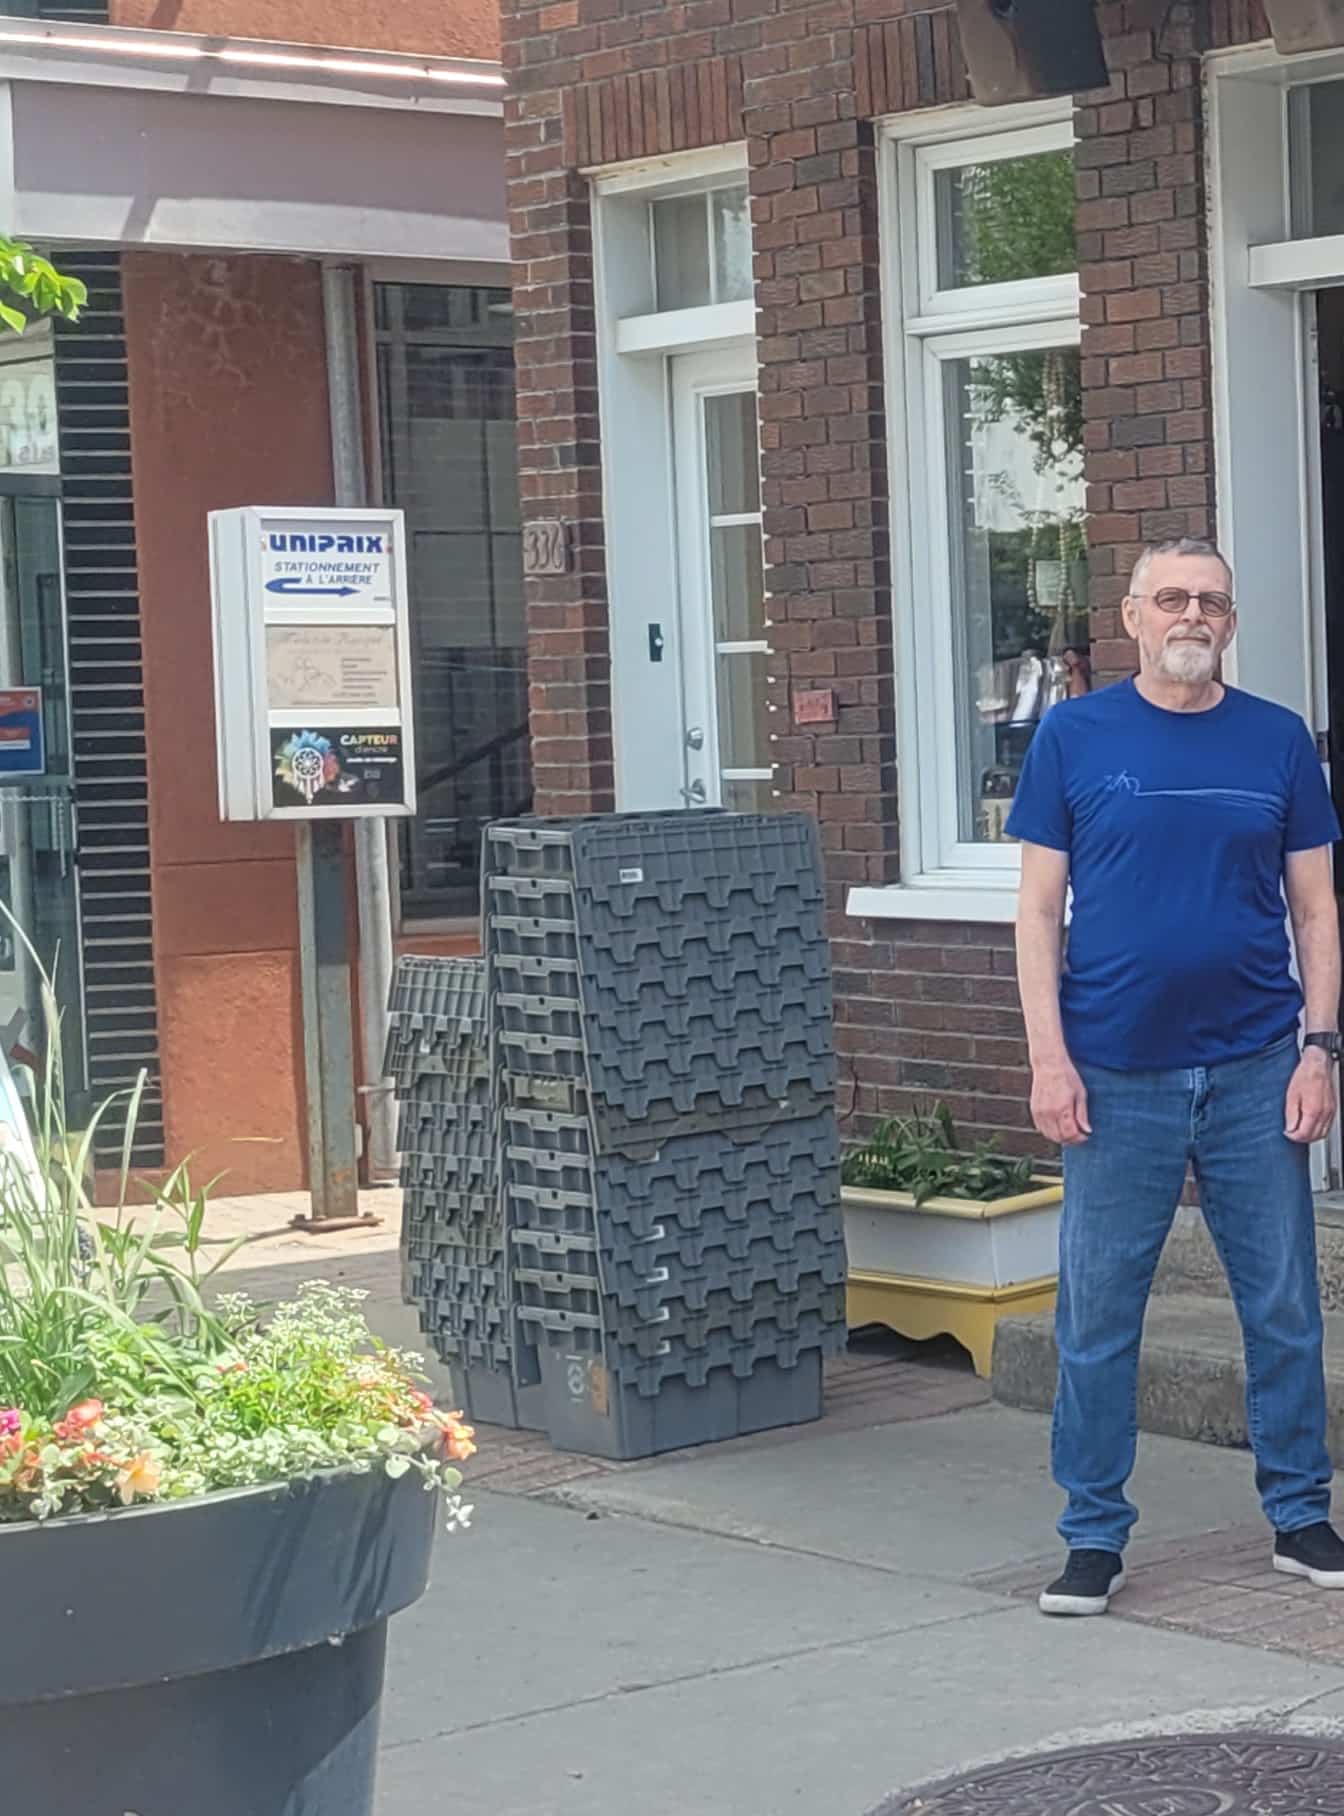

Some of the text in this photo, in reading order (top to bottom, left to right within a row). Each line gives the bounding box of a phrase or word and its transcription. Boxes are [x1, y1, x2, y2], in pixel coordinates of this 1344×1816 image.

[269, 533, 383, 553] UNIPRIX
[274, 561, 380, 573] STATIONNEMENT
[340, 734, 398, 746] CAPTEUR
